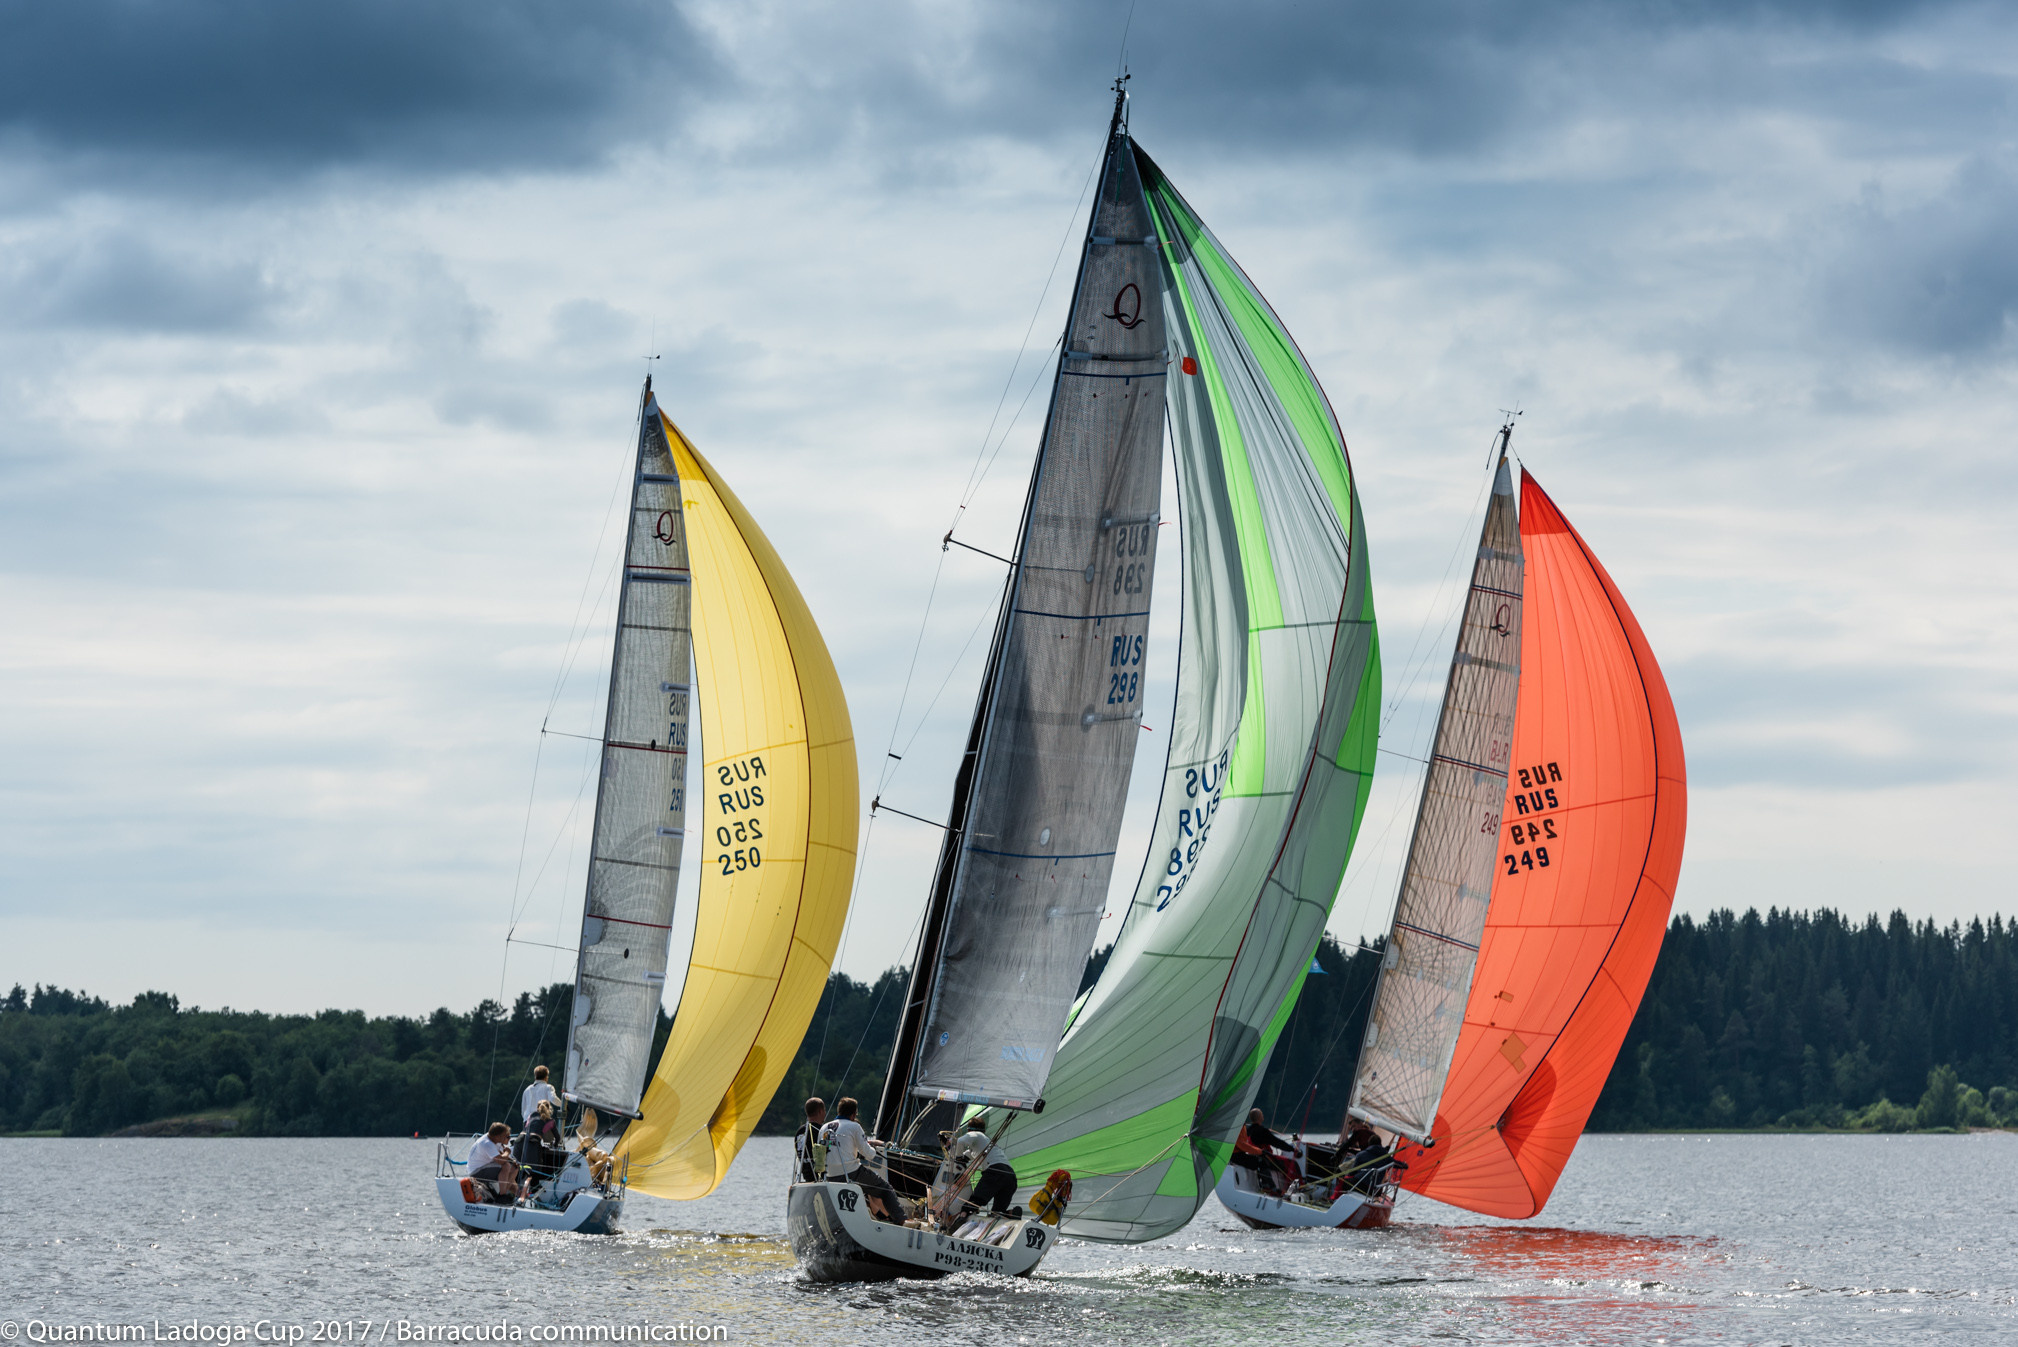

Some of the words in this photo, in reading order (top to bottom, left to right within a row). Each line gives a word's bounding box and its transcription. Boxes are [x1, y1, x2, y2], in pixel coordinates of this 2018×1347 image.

[1110, 634, 1143, 667] RUS
[1107, 671, 1138, 705] 298
[668, 722, 686, 747] RUS
[718, 786, 765, 815] RUS
[1179, 788, 1221, 839] RUS
[1514, 788, 1559, 815] RUS
[1481, 811, 1499, 836] 249
[718, 846, 761, 876] 250
[1504, 846, 1550, 876] 249
[946, 1240, 1004, 1262] АЛЯСКА
